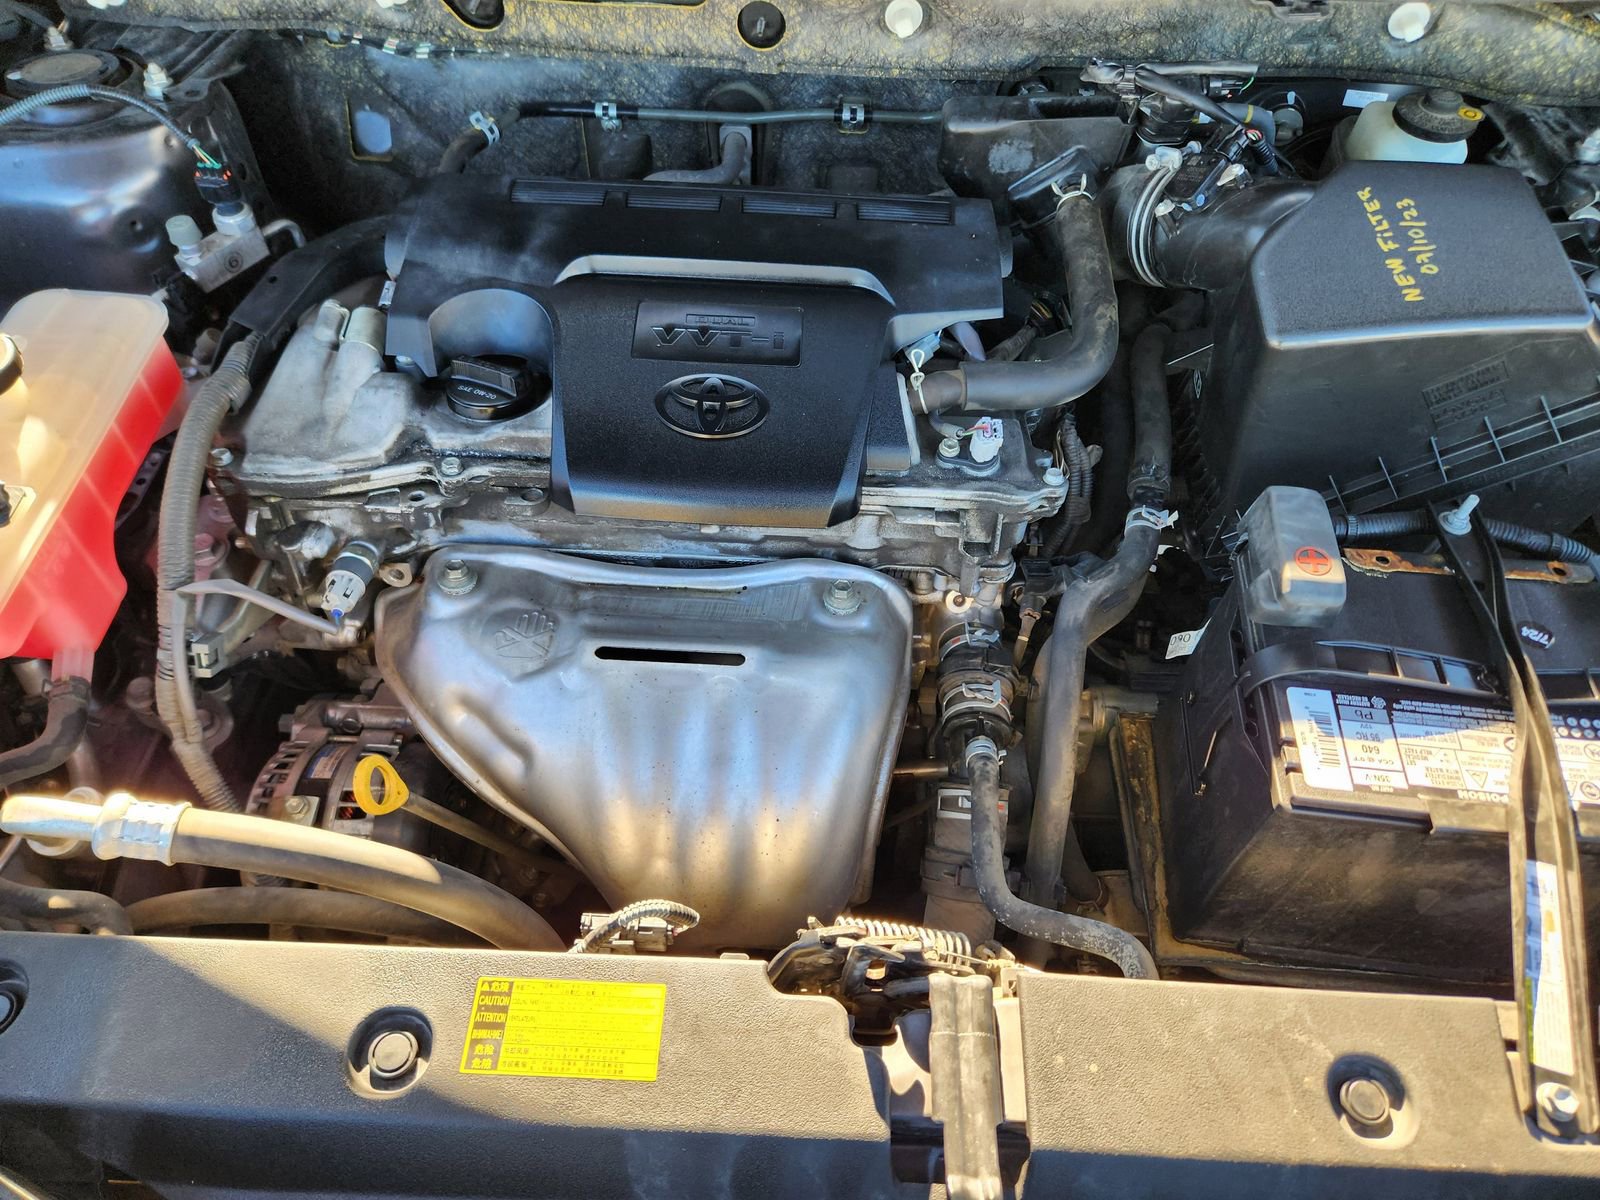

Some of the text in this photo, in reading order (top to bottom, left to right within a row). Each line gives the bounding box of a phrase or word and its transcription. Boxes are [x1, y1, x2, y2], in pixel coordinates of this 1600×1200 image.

[1385, 258, 1425, 302] NEW
[457, 385, 473, 393] SAE
[1354, 710, 1373, 720] Pb
[1361, 745, 1380, 754] 640
[478, 995, 510, 1006] CAUTION
[474, 1011, 507, 1023] ATTENTION
